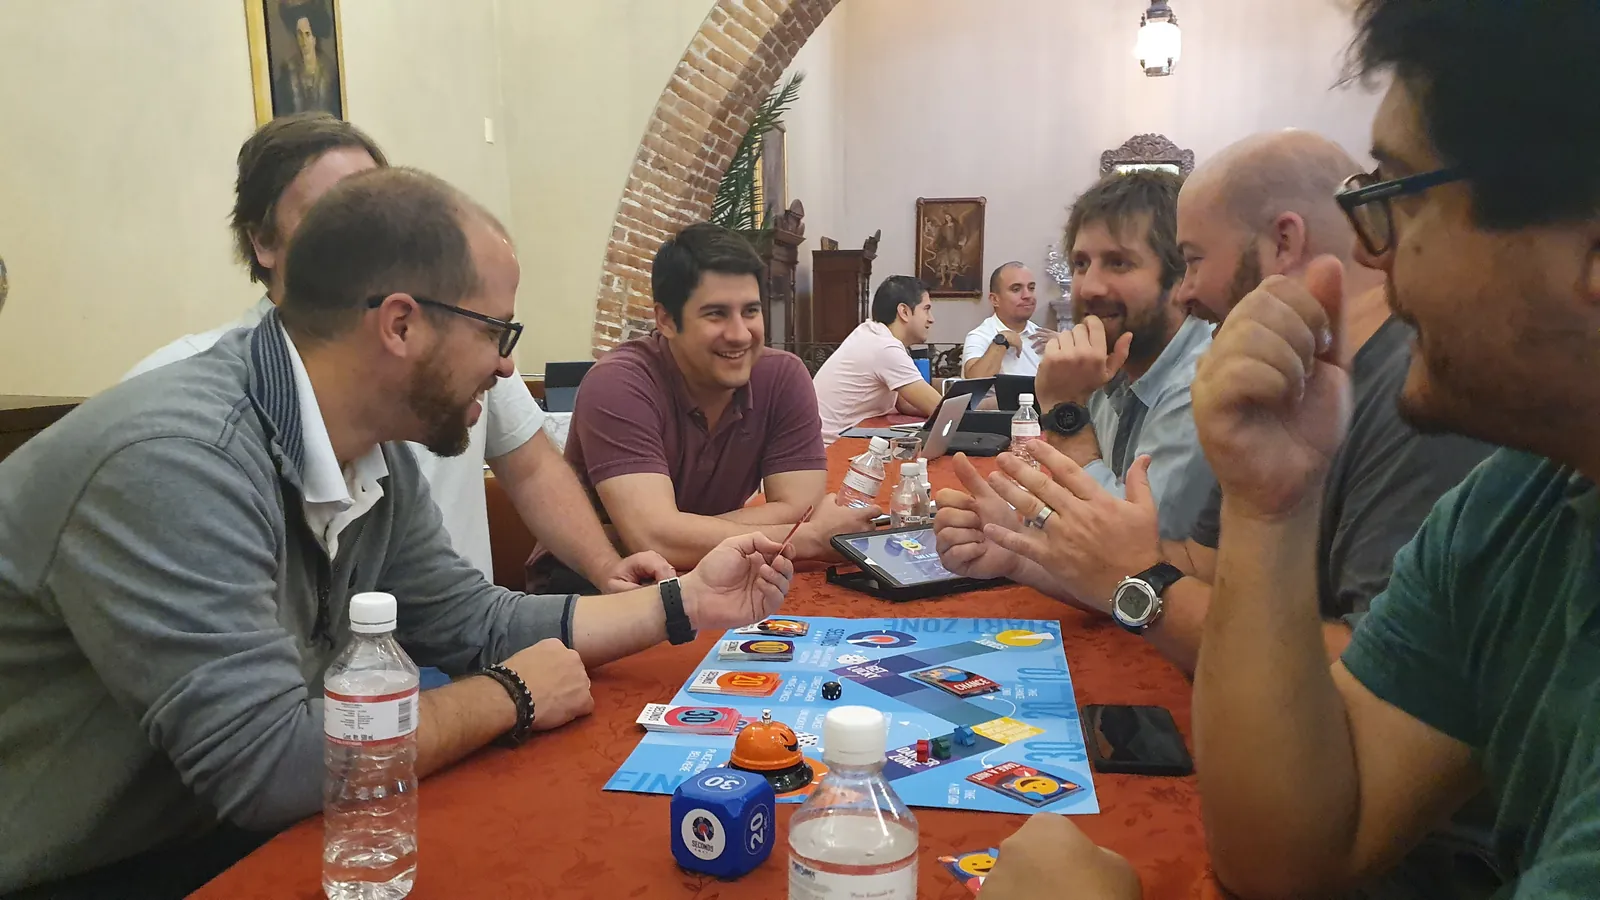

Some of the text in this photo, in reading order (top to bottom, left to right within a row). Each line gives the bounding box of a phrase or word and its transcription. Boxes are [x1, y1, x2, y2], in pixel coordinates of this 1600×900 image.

[884, 618, 1060, 636] START ZONE
[755, 643, 787, 652] 10
[731, 674, 767, 686] 20
[953, 678, 991, 691] CHANCE
[681, 710, 718, 723] 30
[1020, 702, 1079, 719] 20
[1024, 742, 1087, 762] 30
[888, 755, 921, 768] ZONE
[998, 763, 1021, 773] TAKE
[604, 770, 683, 793] FIN
[704, 776, 740, 790] 30
[750, 812, 763, 850] 20
[691, 840, 714, 852] SECONDS
